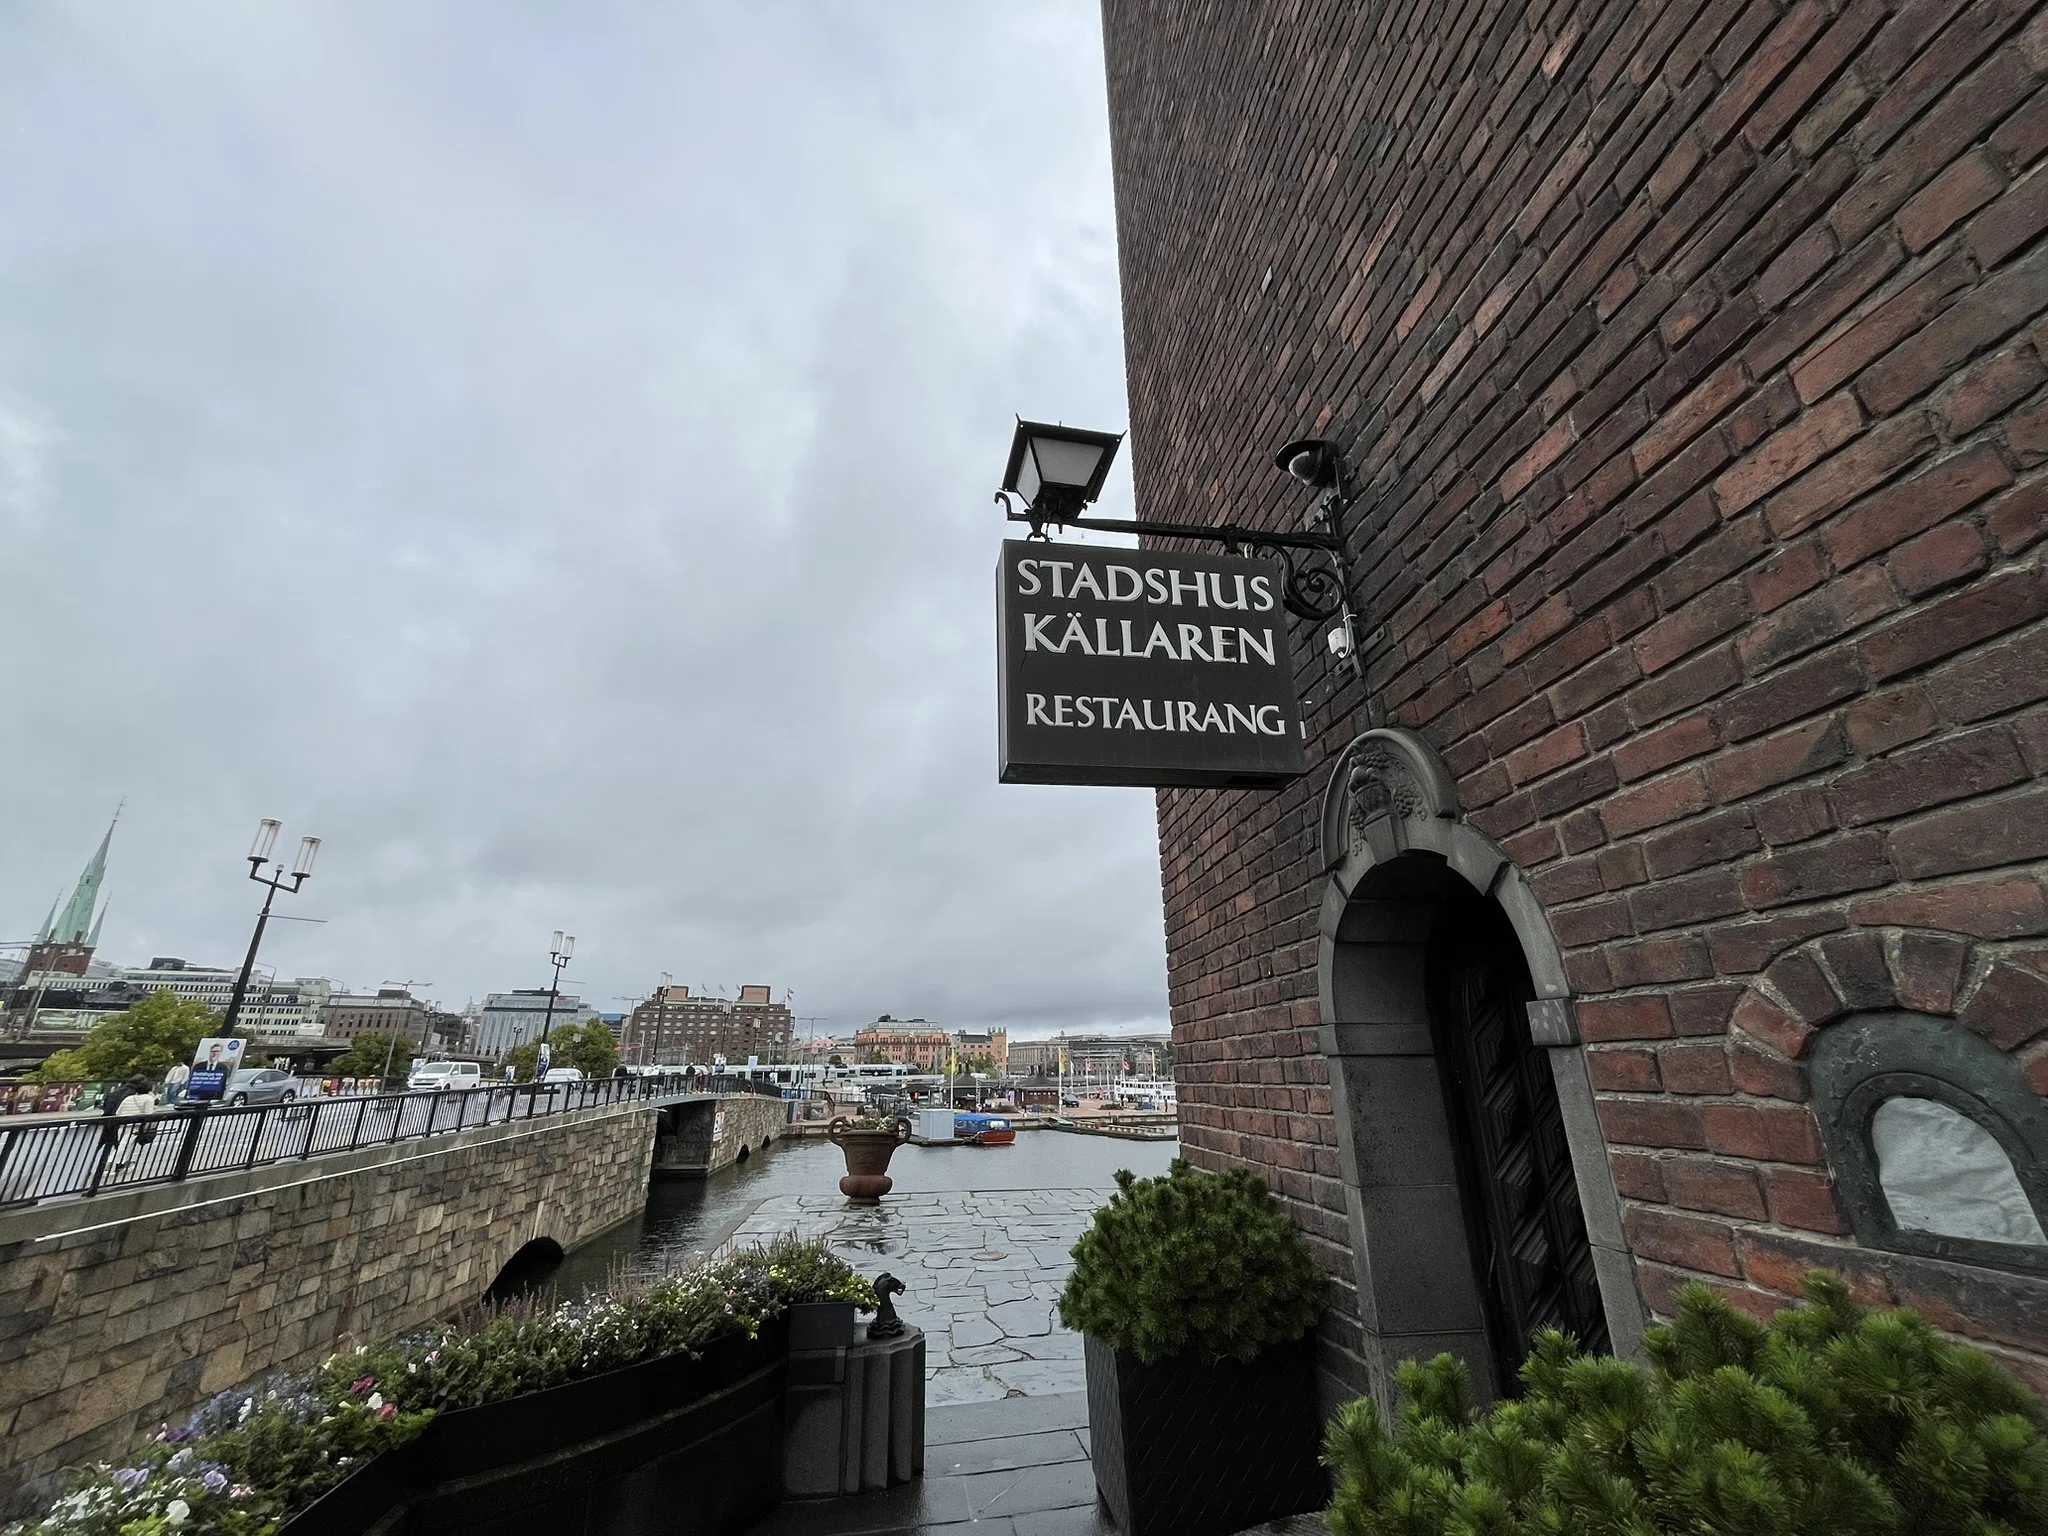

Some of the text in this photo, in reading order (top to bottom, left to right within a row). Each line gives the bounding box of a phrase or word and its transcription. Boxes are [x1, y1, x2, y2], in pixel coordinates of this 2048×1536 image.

[1017, 559, 1274, 612] STADSHUS
[1023, 612, 1276, 666] KÄLLAREN
[1025, 693, 1286, 736] RESTAURANG
